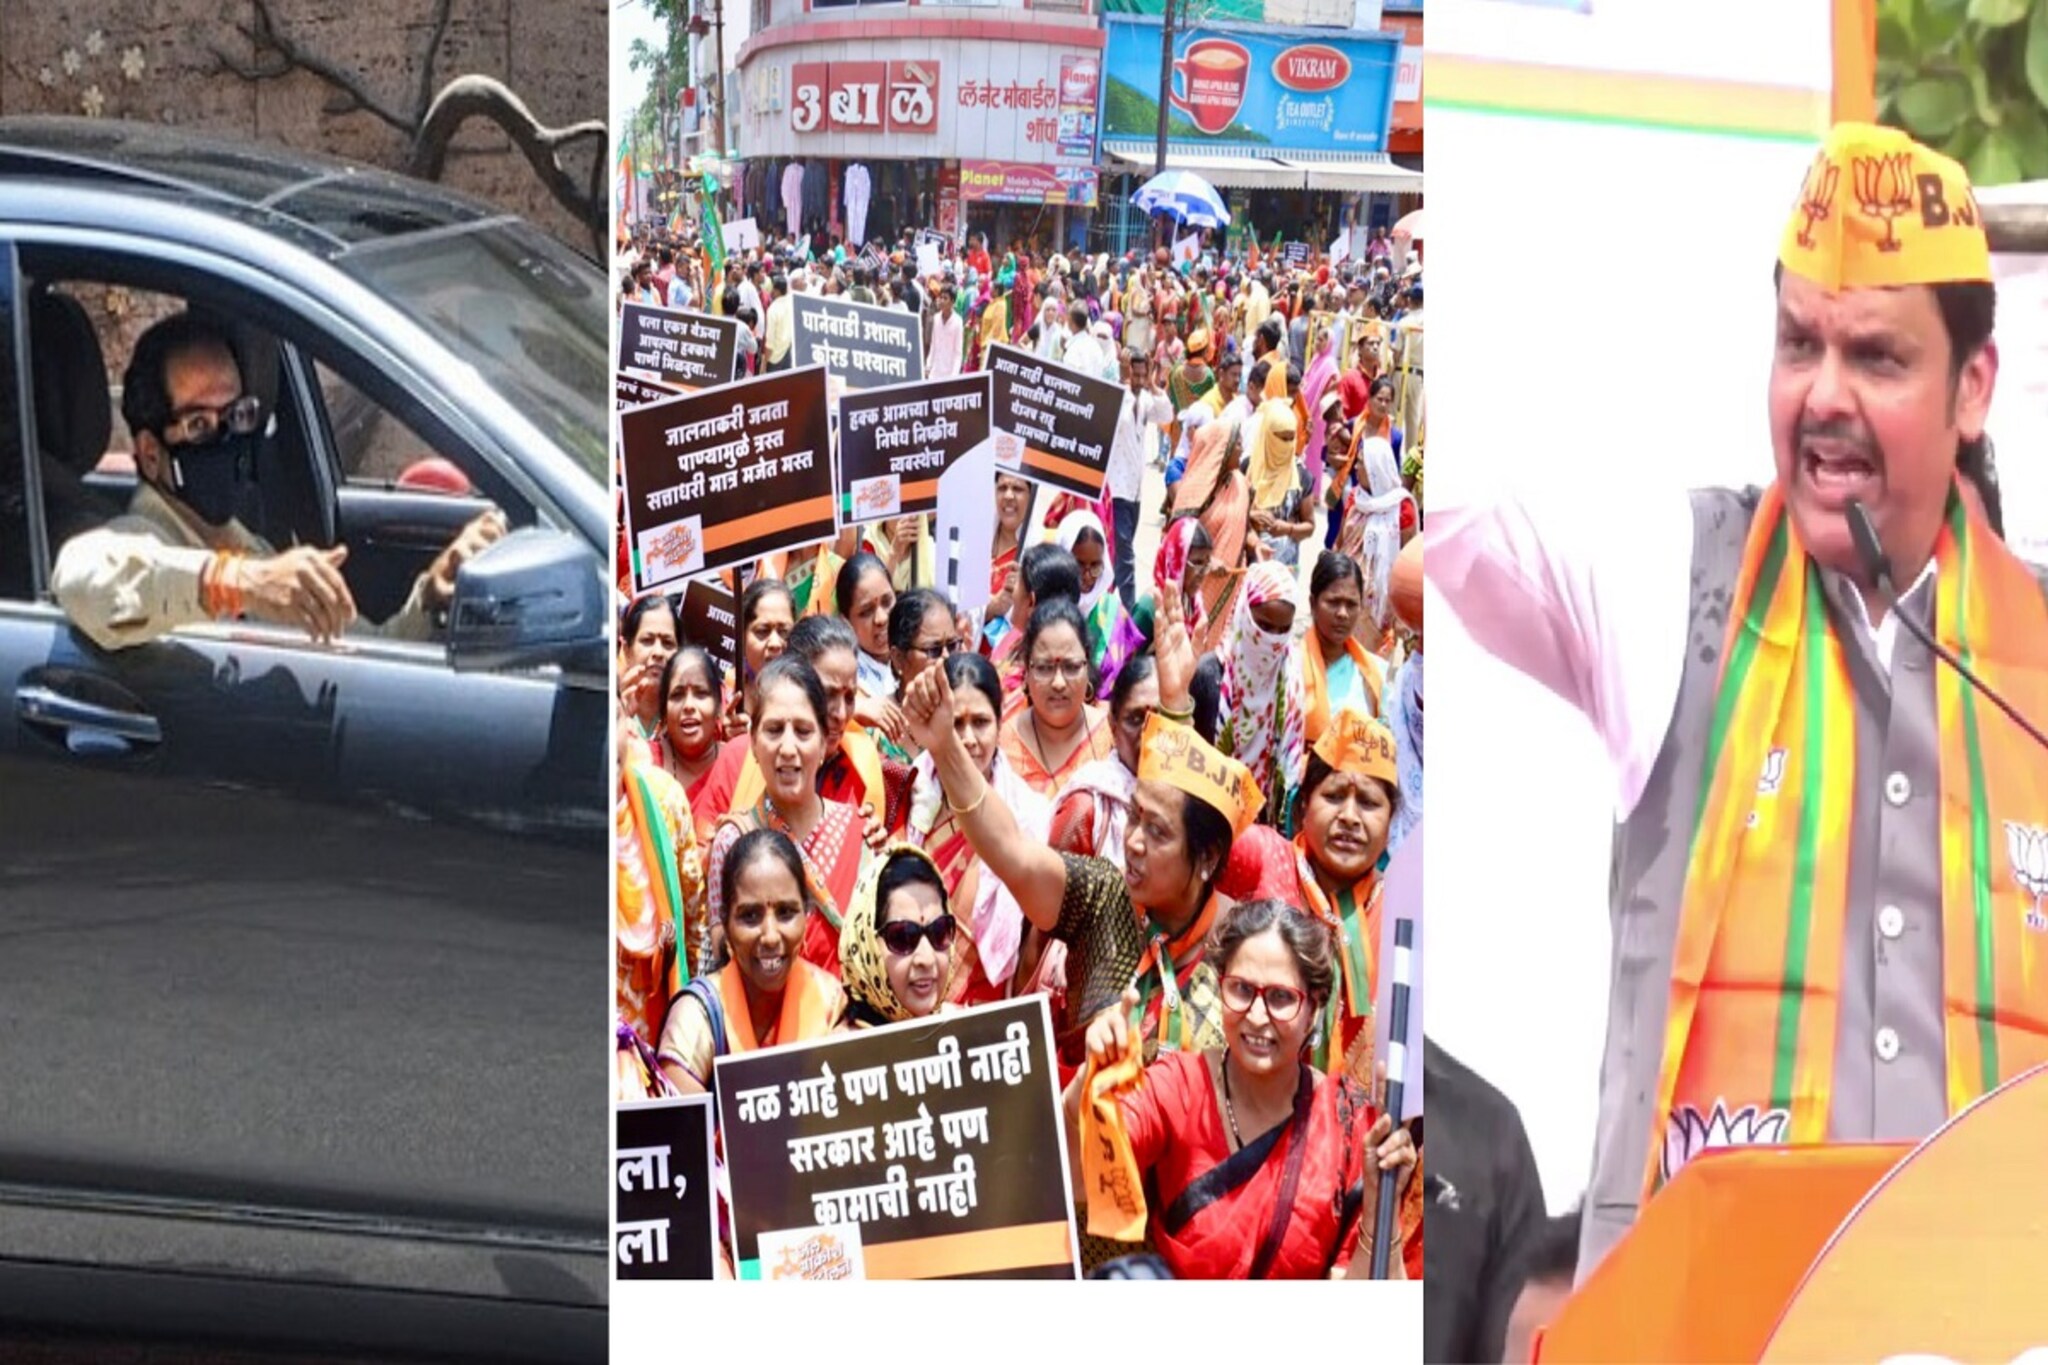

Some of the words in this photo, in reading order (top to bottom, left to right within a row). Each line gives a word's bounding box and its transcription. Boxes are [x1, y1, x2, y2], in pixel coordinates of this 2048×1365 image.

[1288, 58, 1338, 79] VIKRAM
[1004, 78, 1056, 109] मोबाईल
[1286, 102, 1300, 117] TEA
[1301, 102, 1326, 118] OUTLET
[961, 169, 1005, 187] Planet
[802, 307, 860, 339] घानेवाडी
[1020, 365, 1043, 385] नाही
[665, 403, 744, 446] जालनाकरी
[748, 400, 789, 425] जनता
[849, 407, 880, 431] हक्क
[882, 400, 929, 423] आमच्या
[931, 391, 983, 416] पाण्याचा
[677, 431, 750, 469] पाण्यामुळे
[753, 428, 785, 455] त्रस्त
[875, 425, 910, 450] निषेध
[1078, 443, 1103, 462] पाणी
[708, 469, 739, 493] मात्र
[742, 456, 778, 484] मजेत
[781, 449, 815, 473] मस्त
[890, 446, 945, 473] व्यवस्थेचा
[735, 1084, 781, 1123] नळ
[789, 1061, 839, 1118] आहे
[842, 1066, 889, 1105] पण
[893, 1035, 963, 1096] पाणी
[967, 1021, 1032, 1086] नाही
[787, 1127, 876, 1173] सरकार
[882, 1102, 937, 1161] आहे
[940, 1107, 989, 1148] पण
[811, 1164, 910, 1226] कामाची
[914, 1154, 978, 1217] नाही
